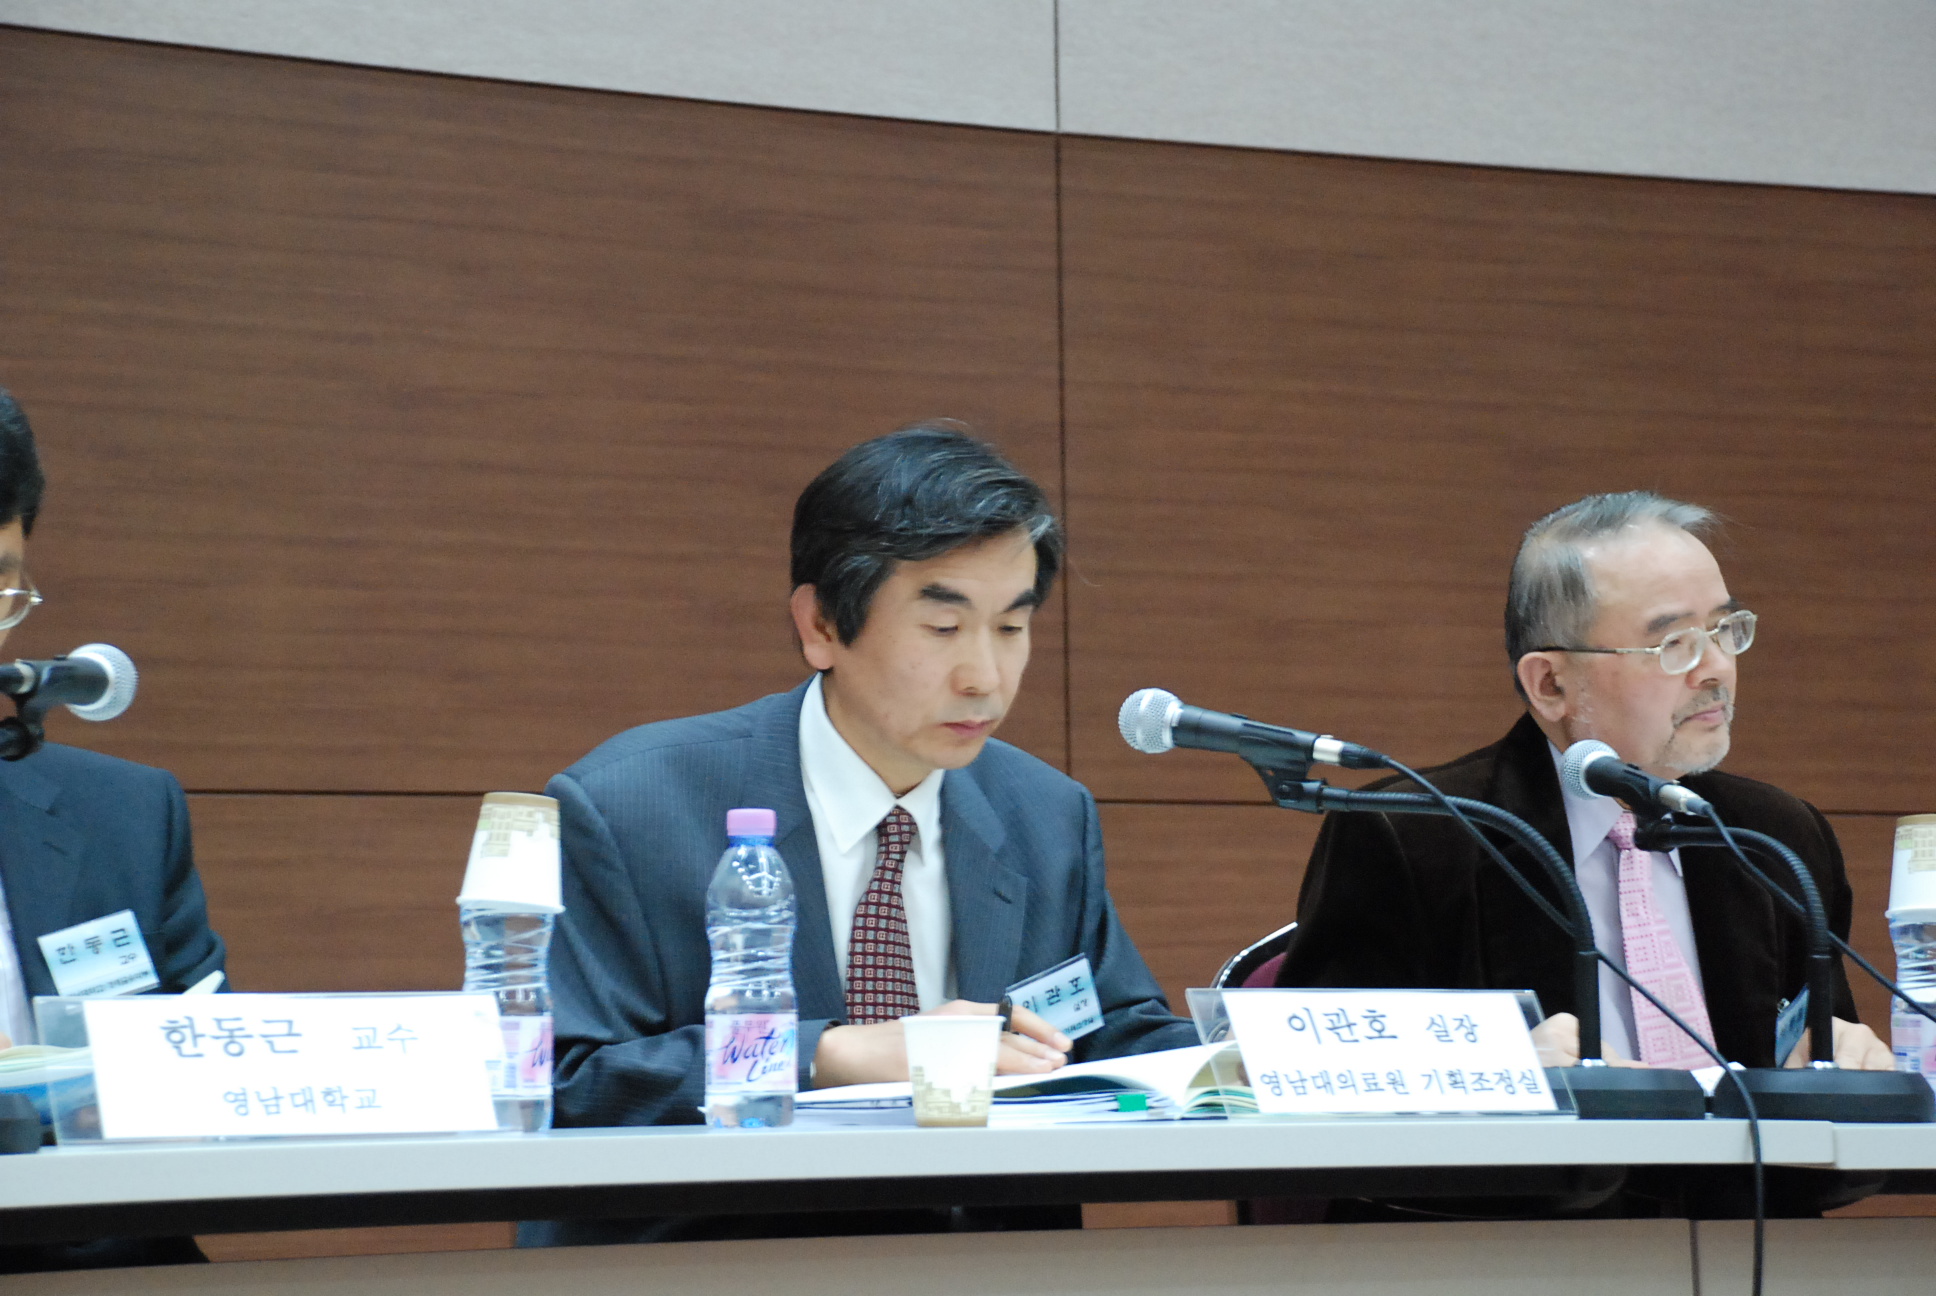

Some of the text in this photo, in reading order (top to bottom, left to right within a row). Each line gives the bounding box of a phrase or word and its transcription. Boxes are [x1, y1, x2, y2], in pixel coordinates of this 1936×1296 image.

[159, 1016, 420, 1058] 한동근 교수
[1287, 1007, 1479, 1045] 이관호 실장
[718, 1028, 789, 1065] Water
[1260, 1068, 1543, 1097] 영남대의료원 기획조정실
[222, 1086, 383, 1117] 영남대학교
